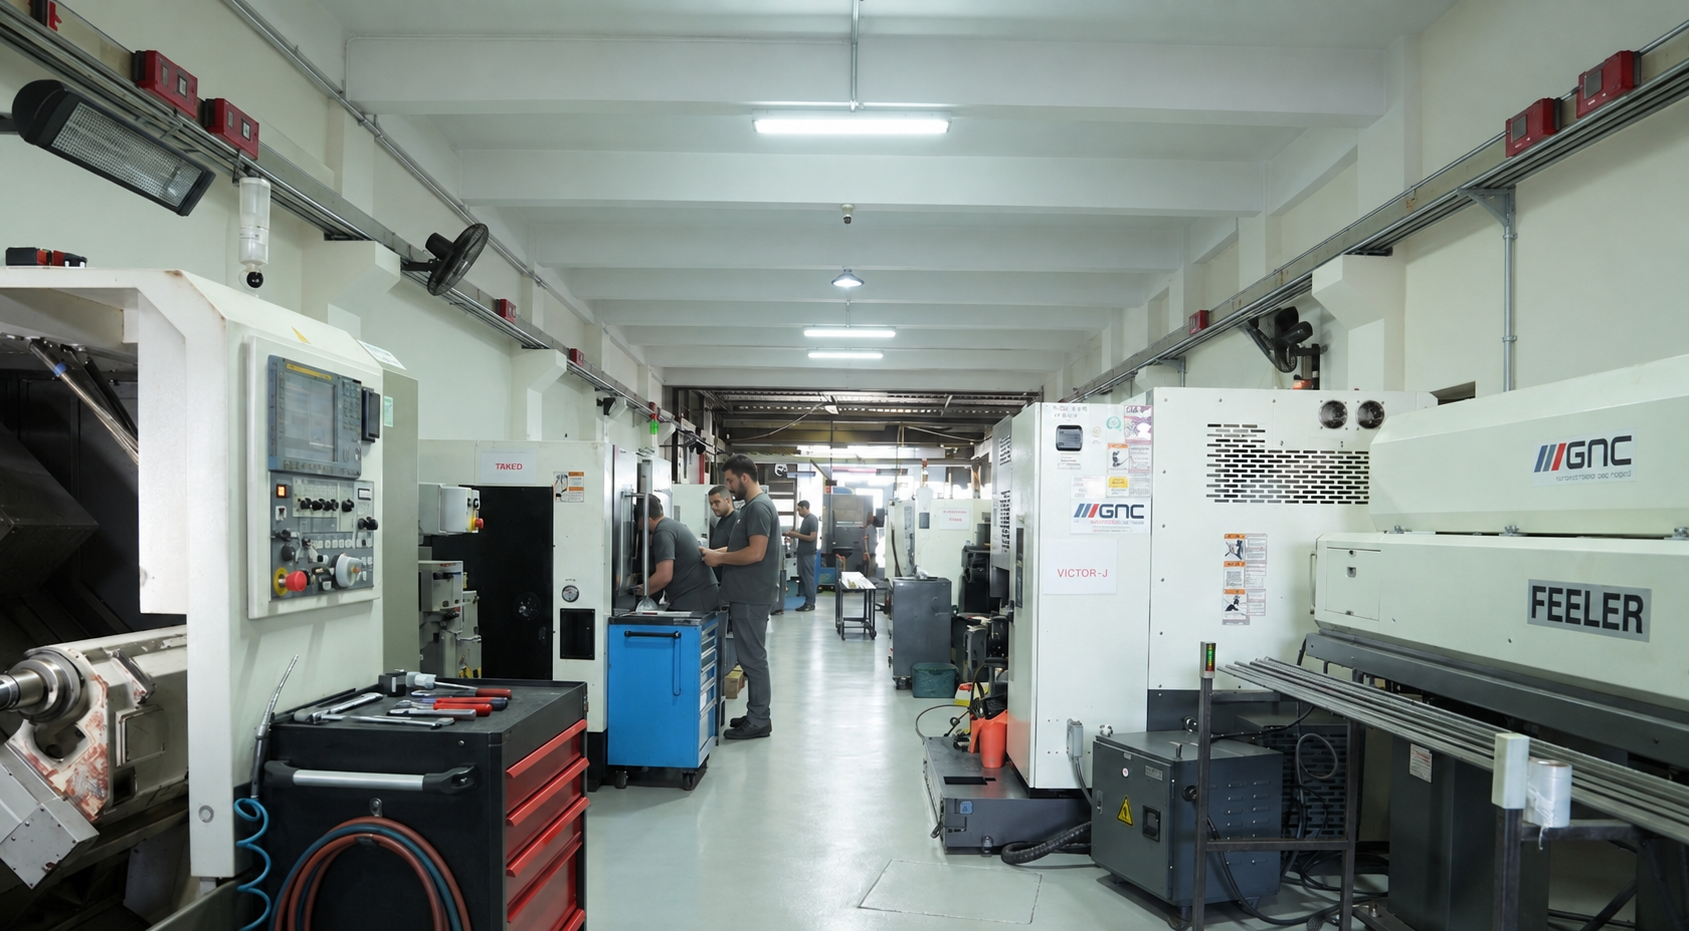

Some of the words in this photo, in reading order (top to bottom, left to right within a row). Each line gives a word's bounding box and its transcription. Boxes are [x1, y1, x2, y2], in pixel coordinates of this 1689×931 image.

[1566, 435, 1632, 470] GNC
[1099, 503, 1145, 519] GNC
[1531, 585, 1644, 634] FEELER
